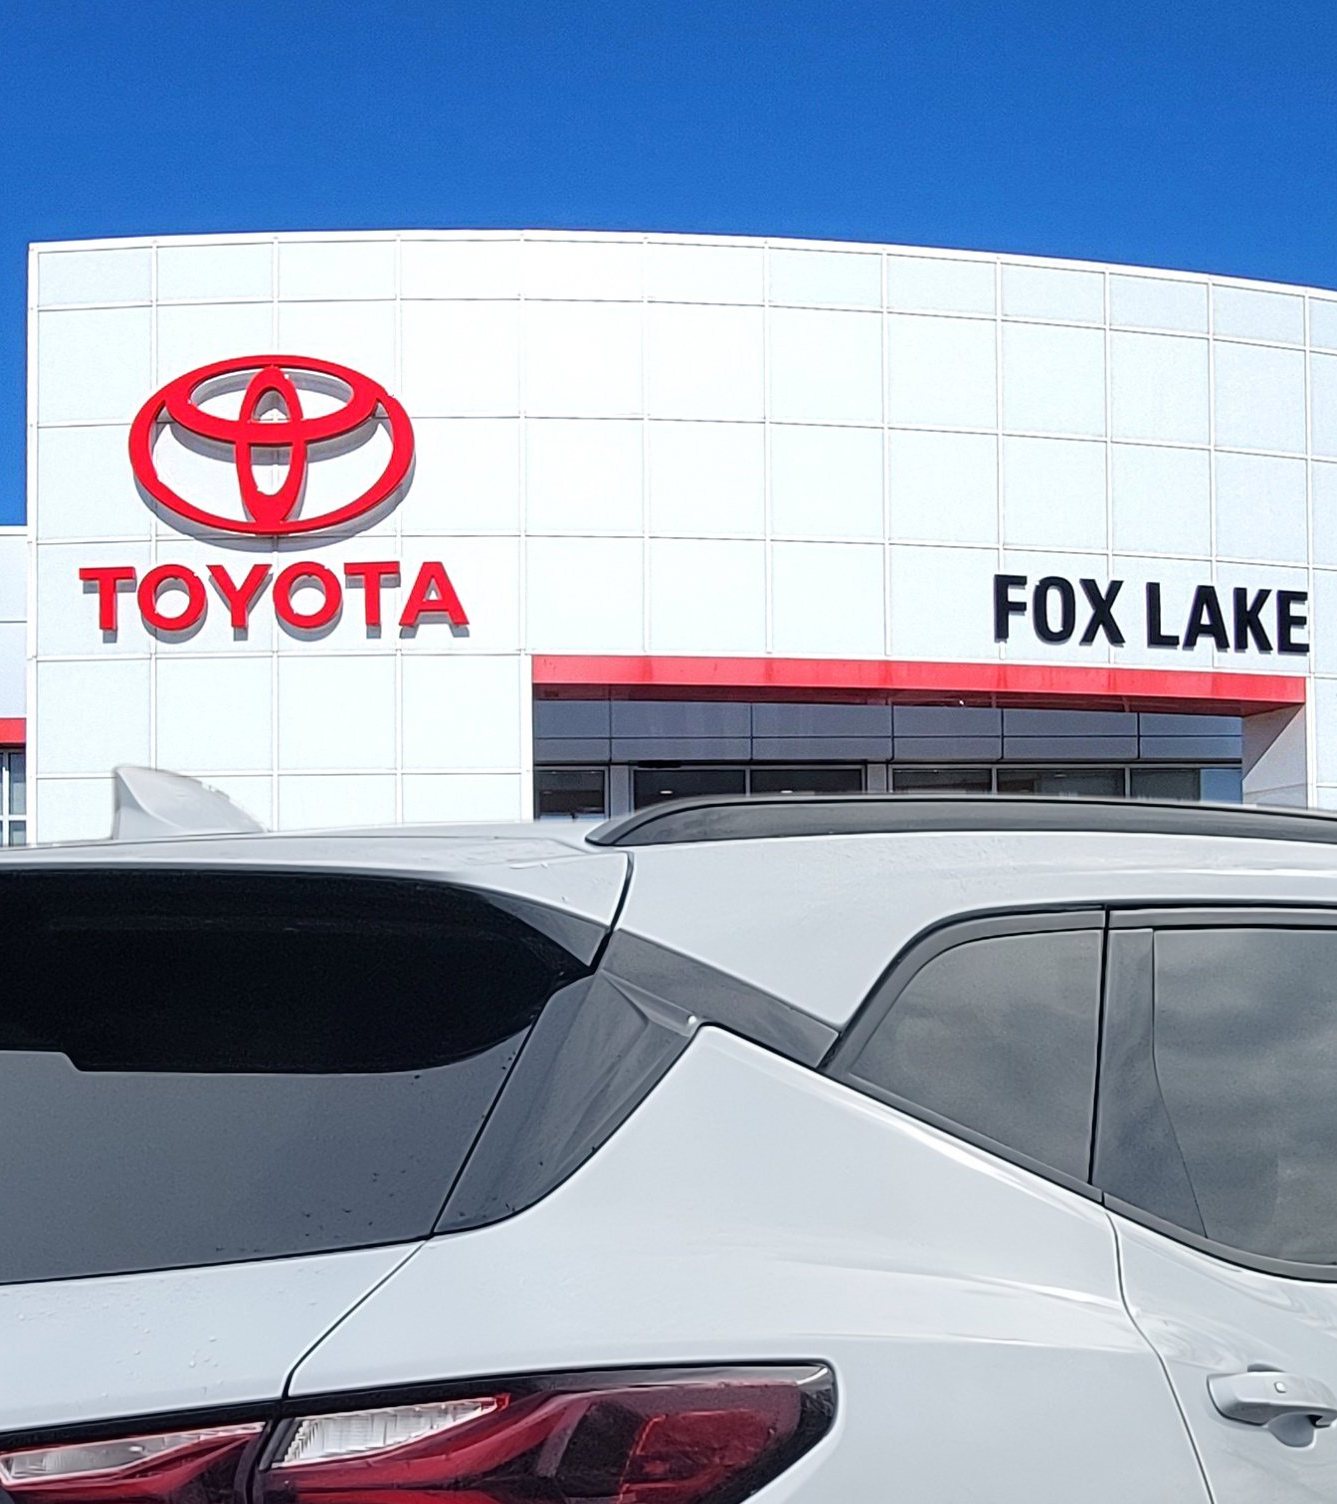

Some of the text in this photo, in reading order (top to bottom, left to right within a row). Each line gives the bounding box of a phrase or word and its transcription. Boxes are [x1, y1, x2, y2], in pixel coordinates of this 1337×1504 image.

[78, 560, 470, 632] TOYOTA
[993, 573, 1311, 654] FOX LAKE
